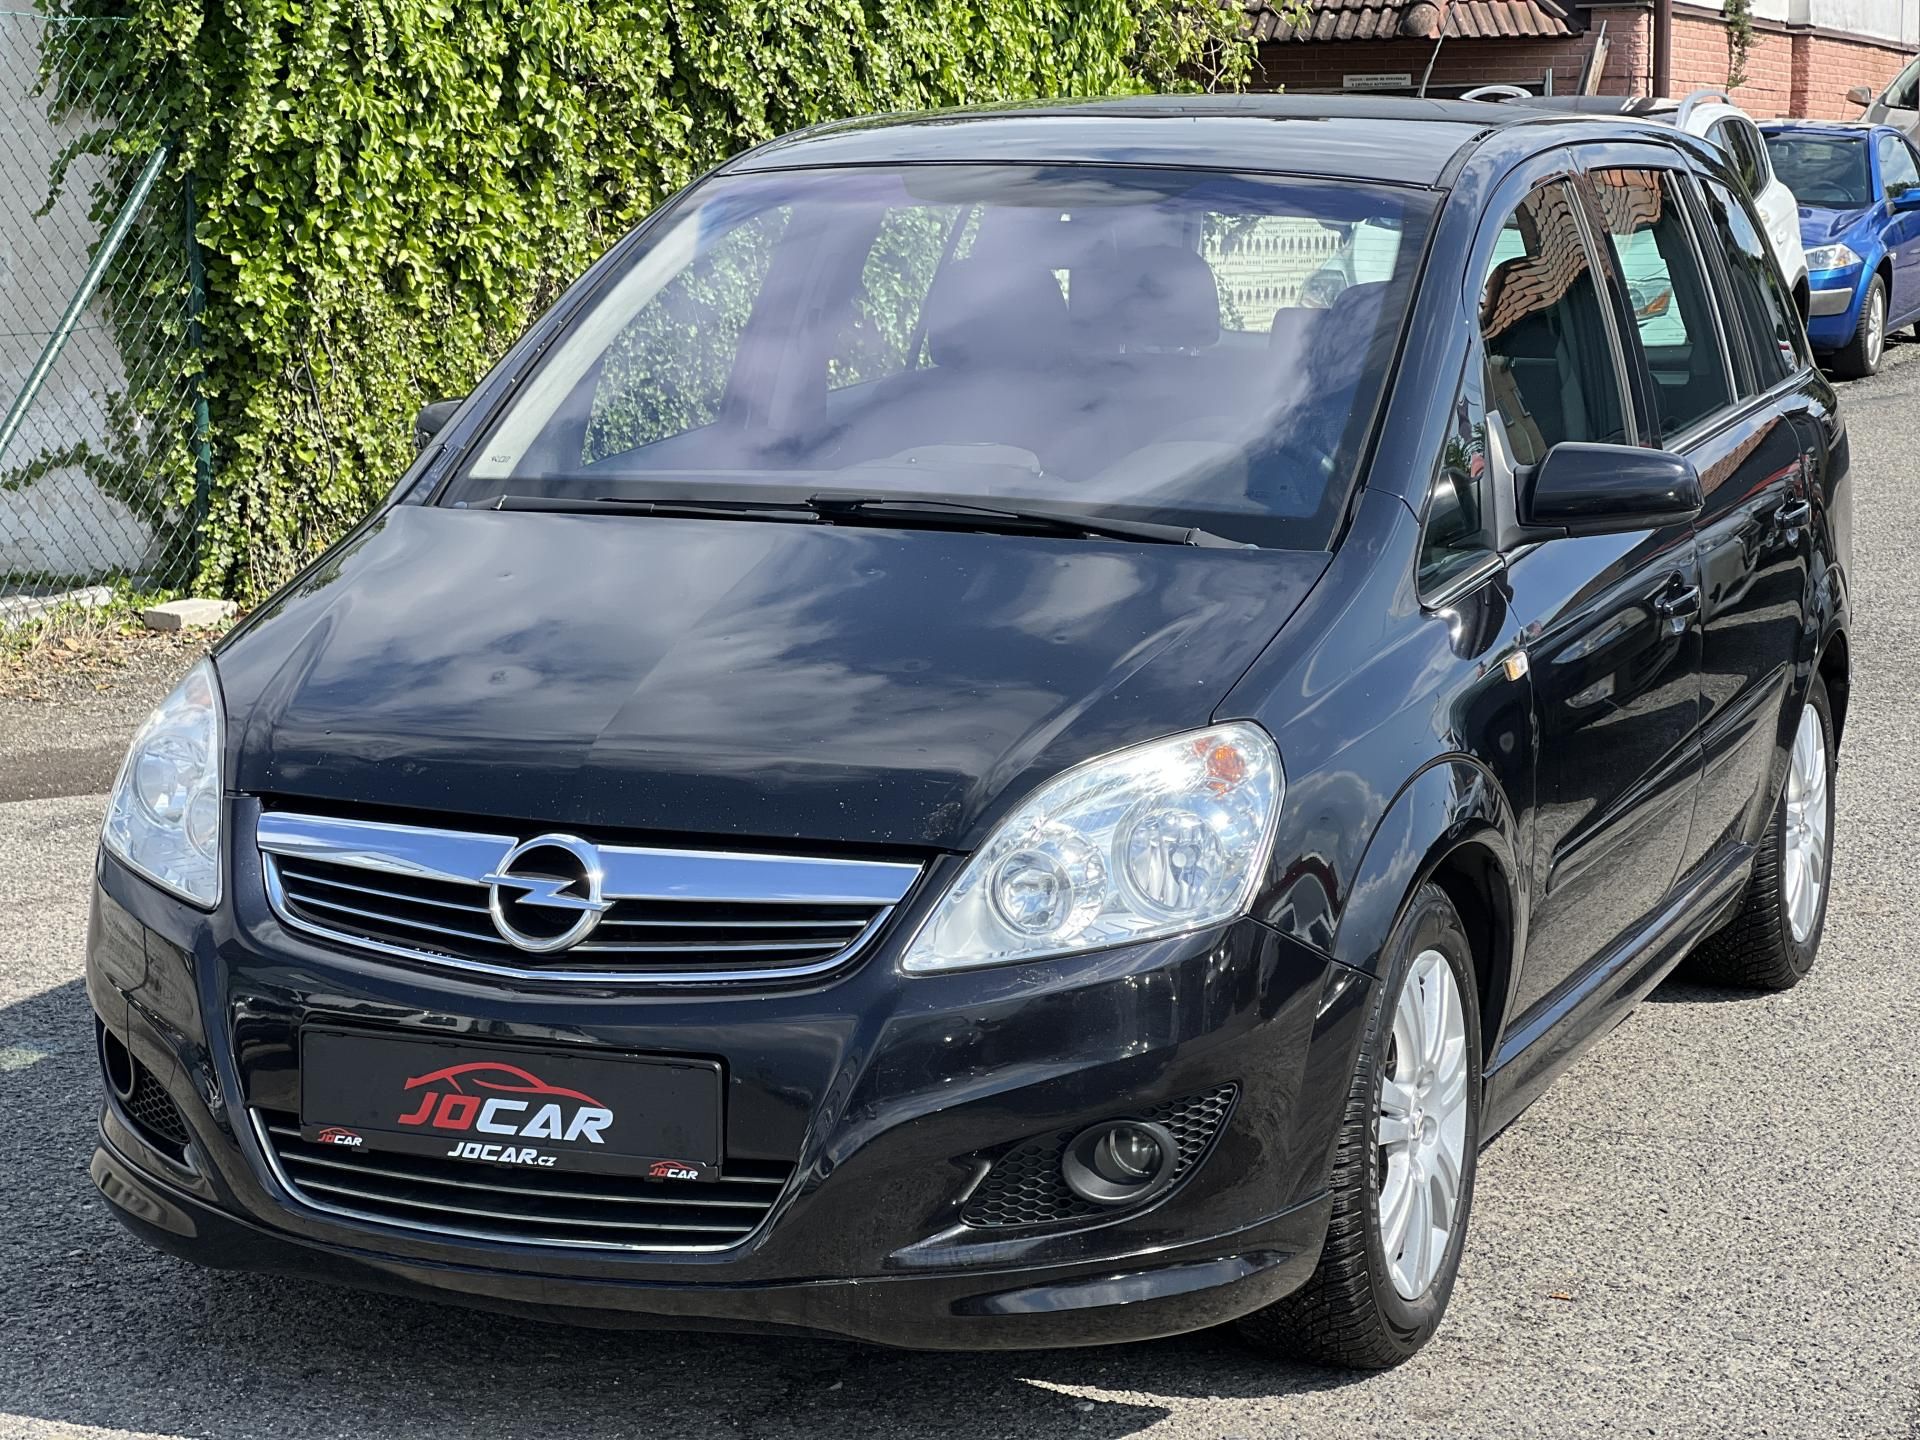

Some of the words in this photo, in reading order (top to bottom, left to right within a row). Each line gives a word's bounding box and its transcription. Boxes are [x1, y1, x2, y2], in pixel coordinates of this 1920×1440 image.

[397, 1091, 614, 1144] JOCAR
[317, 1133, 363, 1147] JOCAR
[447, 1141, 558, 1166] JOCAR.cz
[648, 1167, 699, 1180] JOCAR
